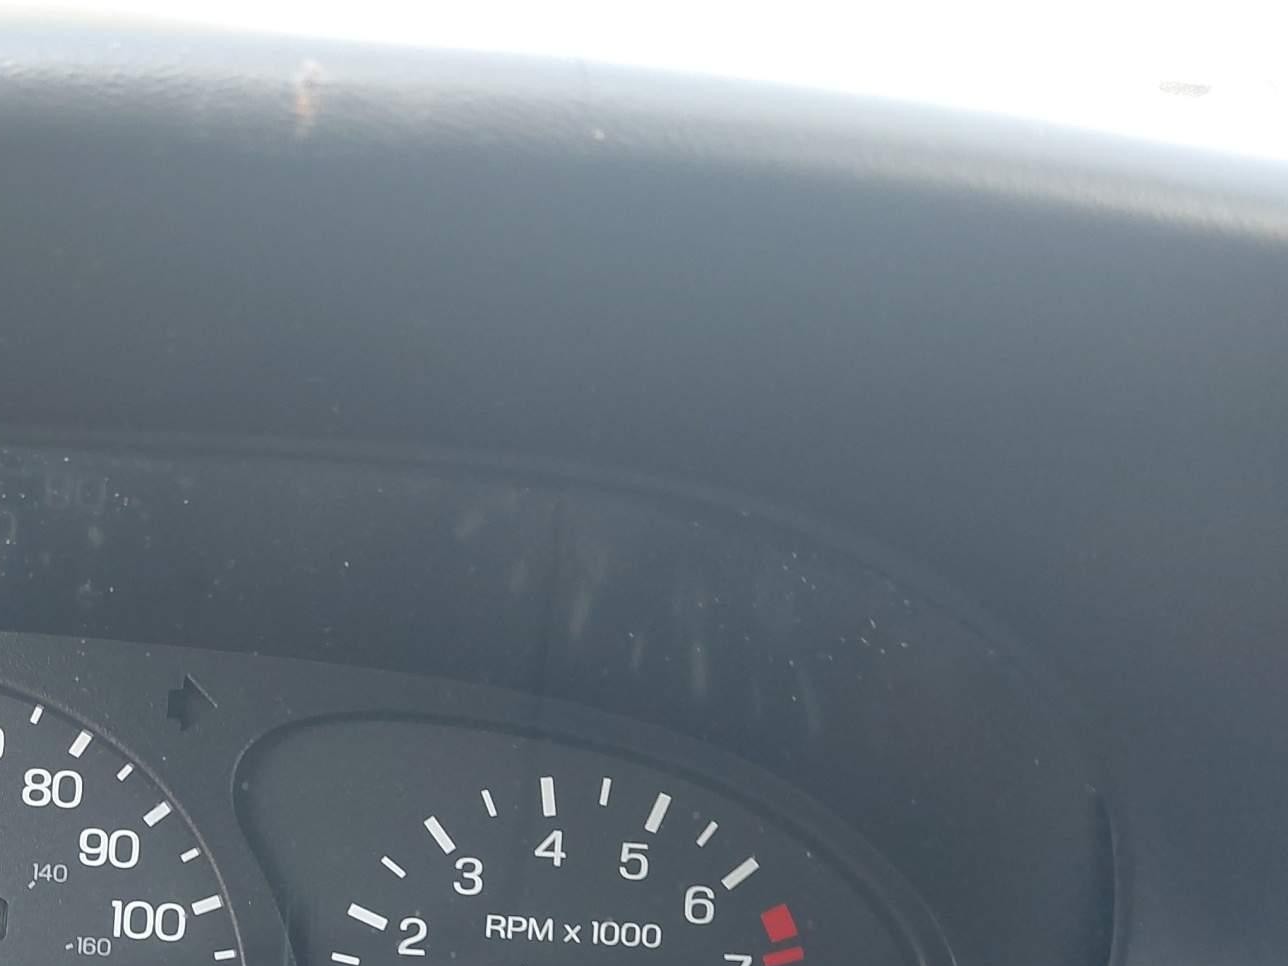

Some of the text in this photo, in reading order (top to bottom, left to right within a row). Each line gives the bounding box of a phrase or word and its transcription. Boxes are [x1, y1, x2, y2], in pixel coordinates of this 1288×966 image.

[22, 769, 82, 808] 80
[80, 829, 139, 868] 90
[535, 831, 566, 866] 4
[620, 843, 648, 879] 5
[34, 864, 67, 882] 140
[454, 858, 482, 895] 3
[112, 901, 185, 941] 100
[685, 886, 714, 923] 6
[77, 937, 111, 955] 160
[398, 918, 426, 955] 2
[486, 915, 553, 941] RPM
[592, 921, 661, 947] 1000
